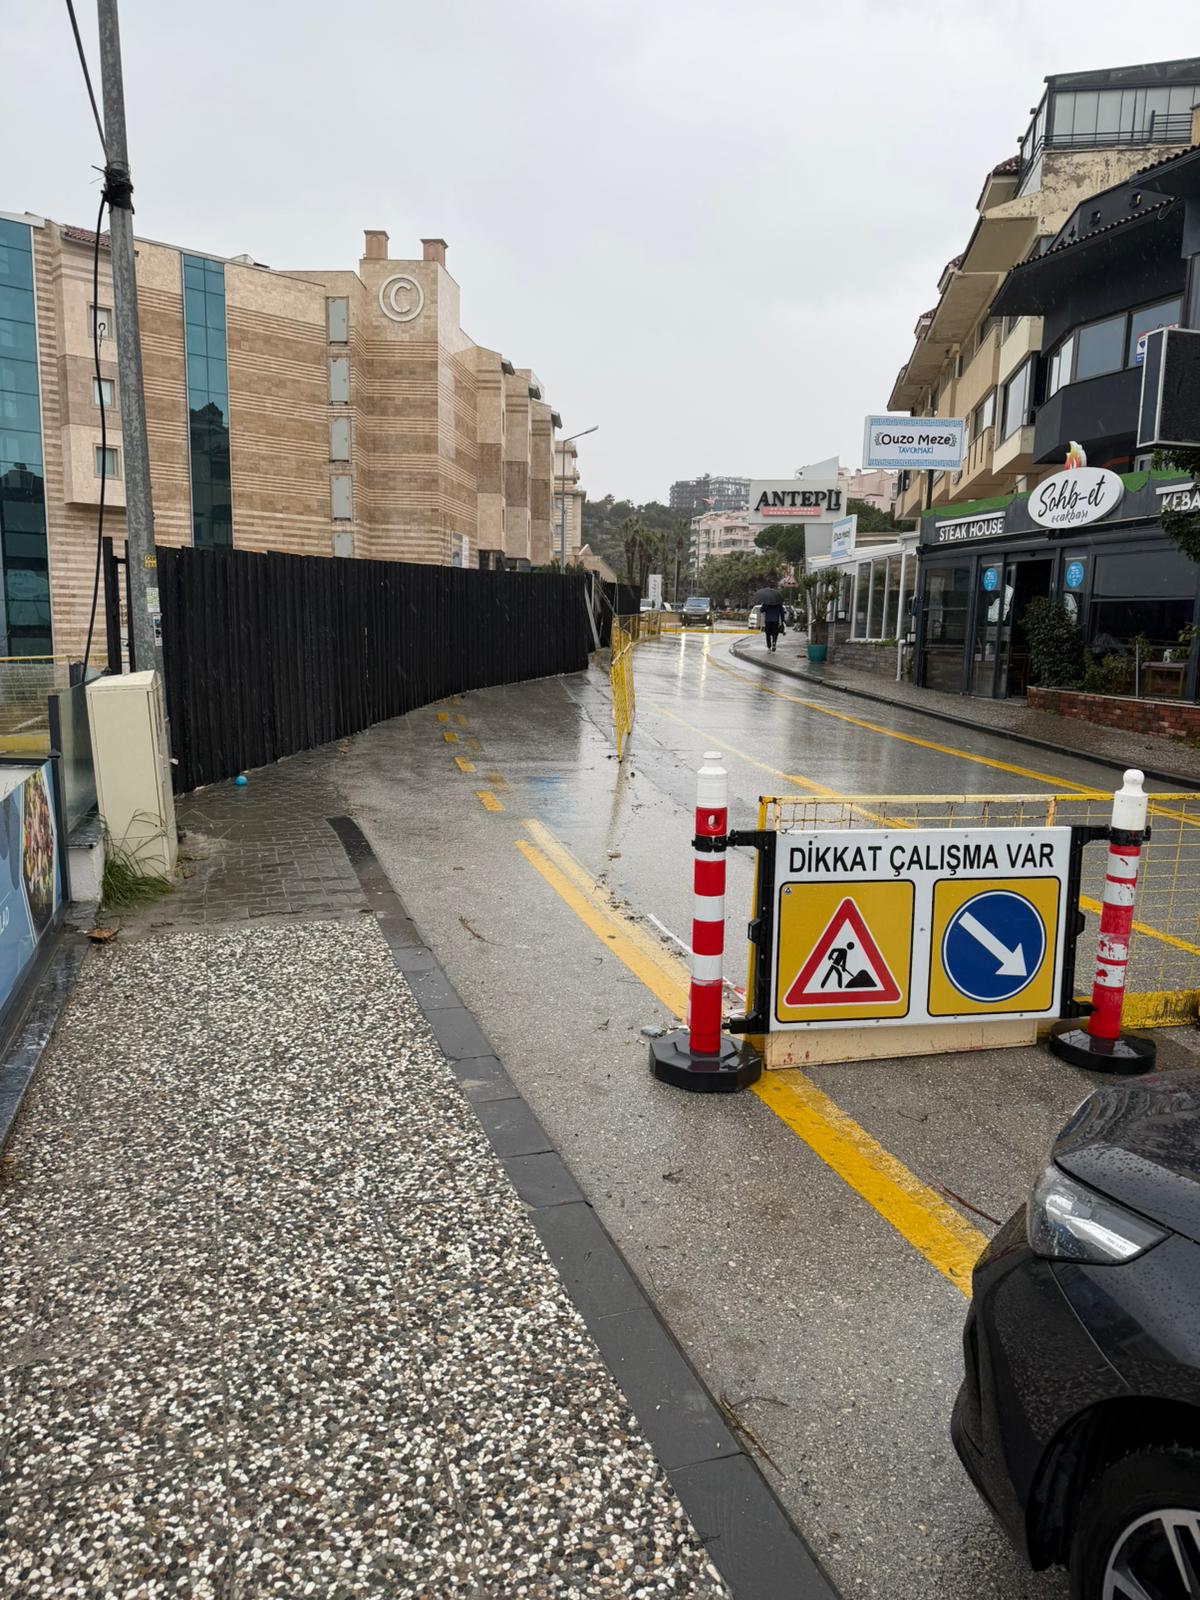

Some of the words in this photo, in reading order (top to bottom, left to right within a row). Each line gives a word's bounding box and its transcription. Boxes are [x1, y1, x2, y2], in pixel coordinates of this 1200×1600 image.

[881, 433, 914, 446] Ouzo
[918, 434, 951, 446] Meze
[1038, 474, 1106, 518] Sohb-et
[939, 523, 968, 542] STEAK
[969, 518, 1004, 537] HOUSE
[789, 840, 882, 873] DİKKAT
[889, 843, 999, 877] ÇALIŞMA
[1006, 843, 1054, 869] VAR
